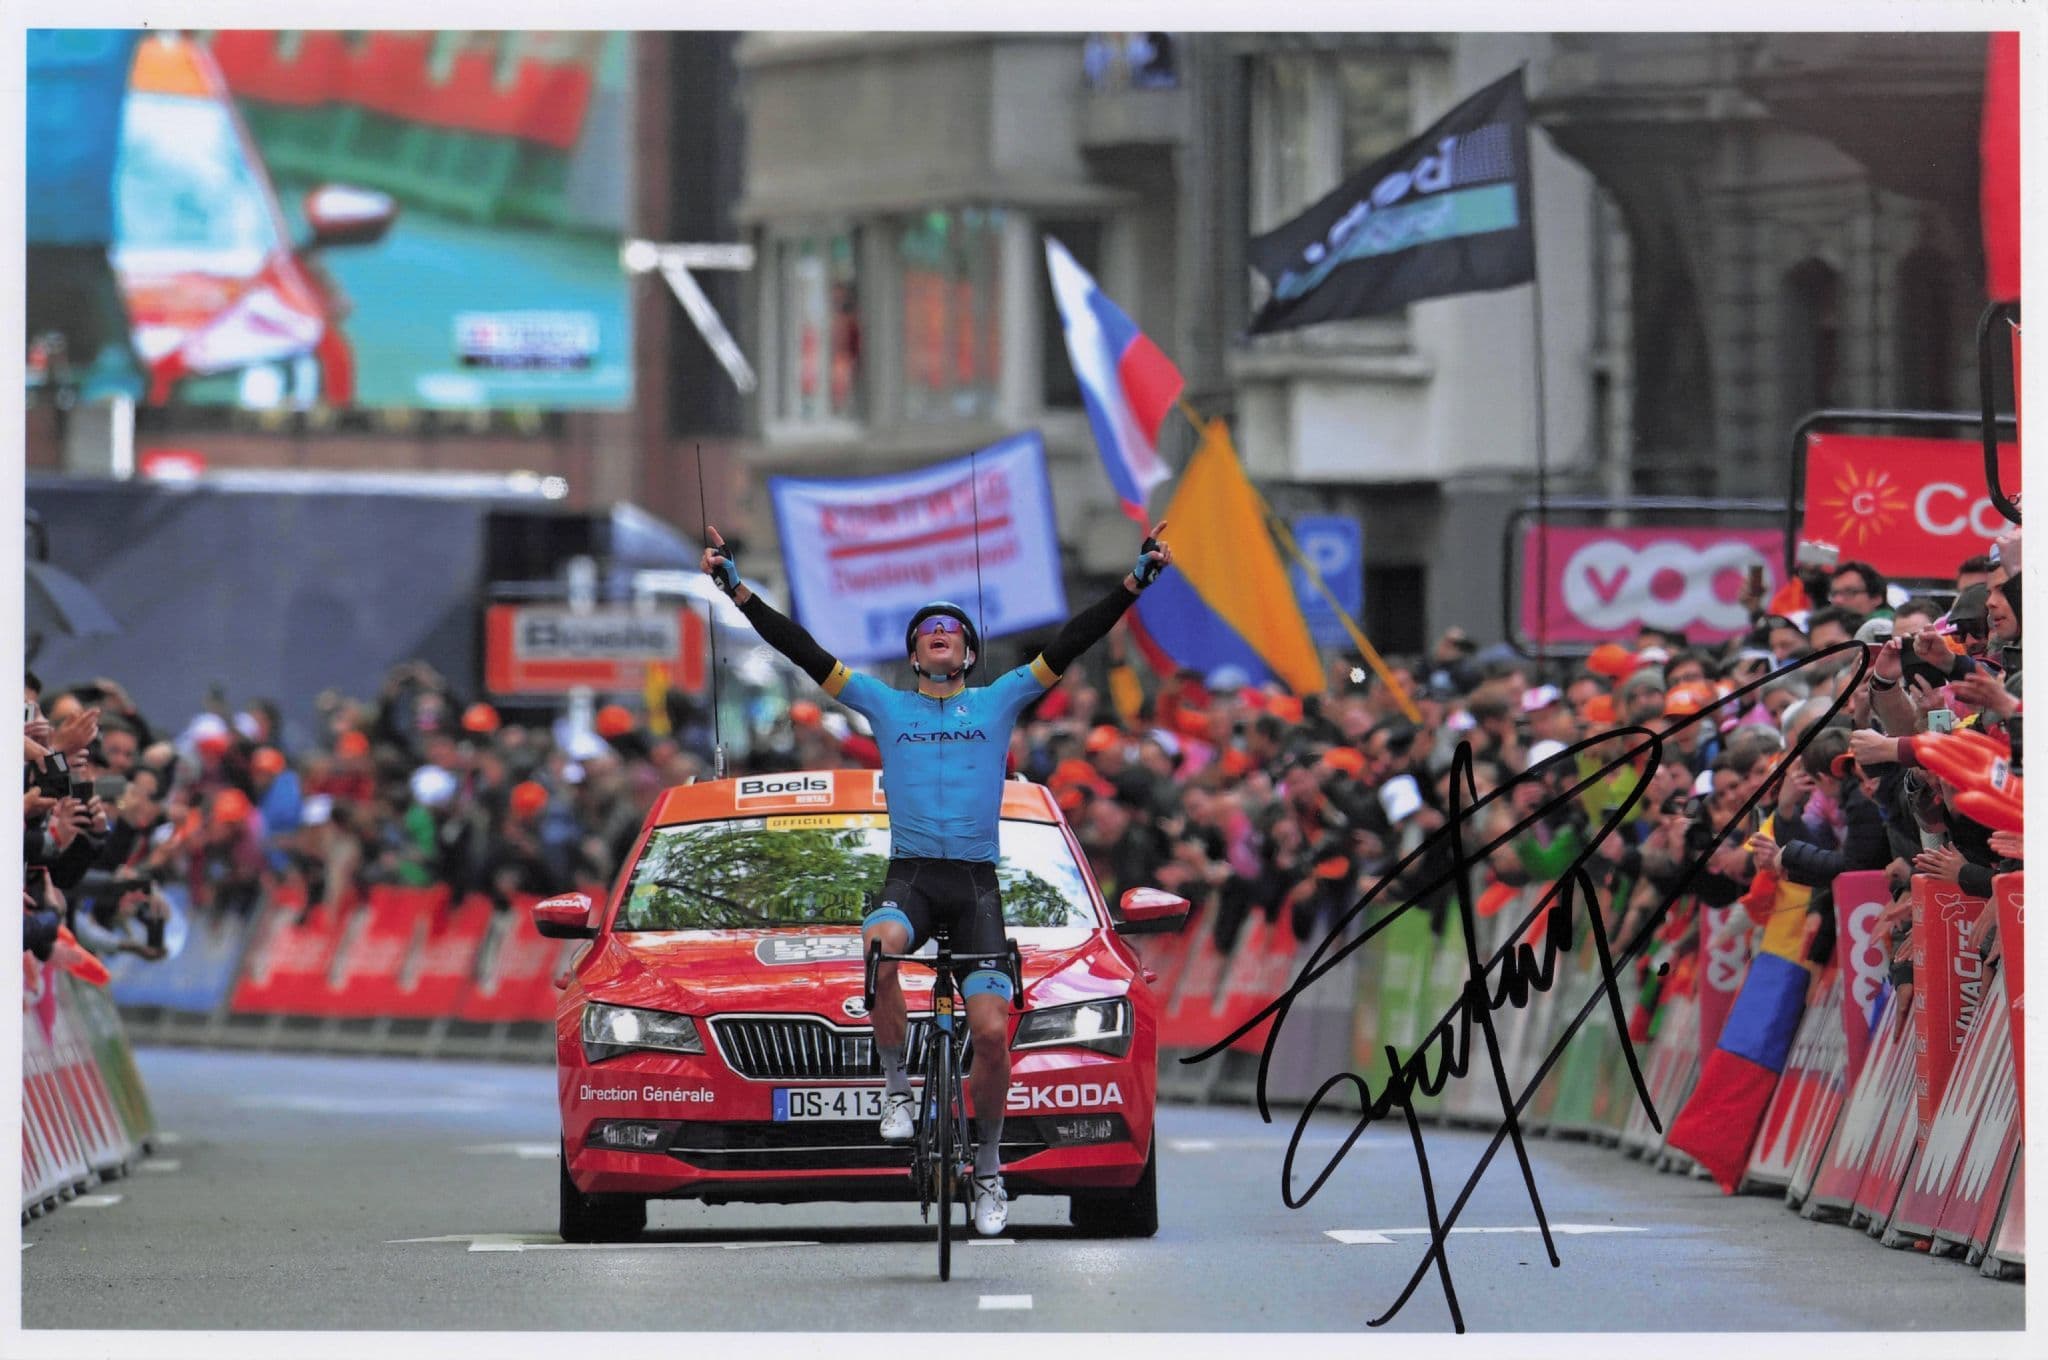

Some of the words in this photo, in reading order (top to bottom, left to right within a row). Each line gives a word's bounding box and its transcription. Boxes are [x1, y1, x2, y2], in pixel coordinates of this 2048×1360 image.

[896, 729, 987, 744] ASTANA
[741, 777, 828, 795] Boels
[580, 1084, 638, 1101] Direction
[642, 1086, 715, 1102] Générale
[1006, 1082, 1124, 1110] ŠKODA
[790, 1091, 882, 1117] DS-413
